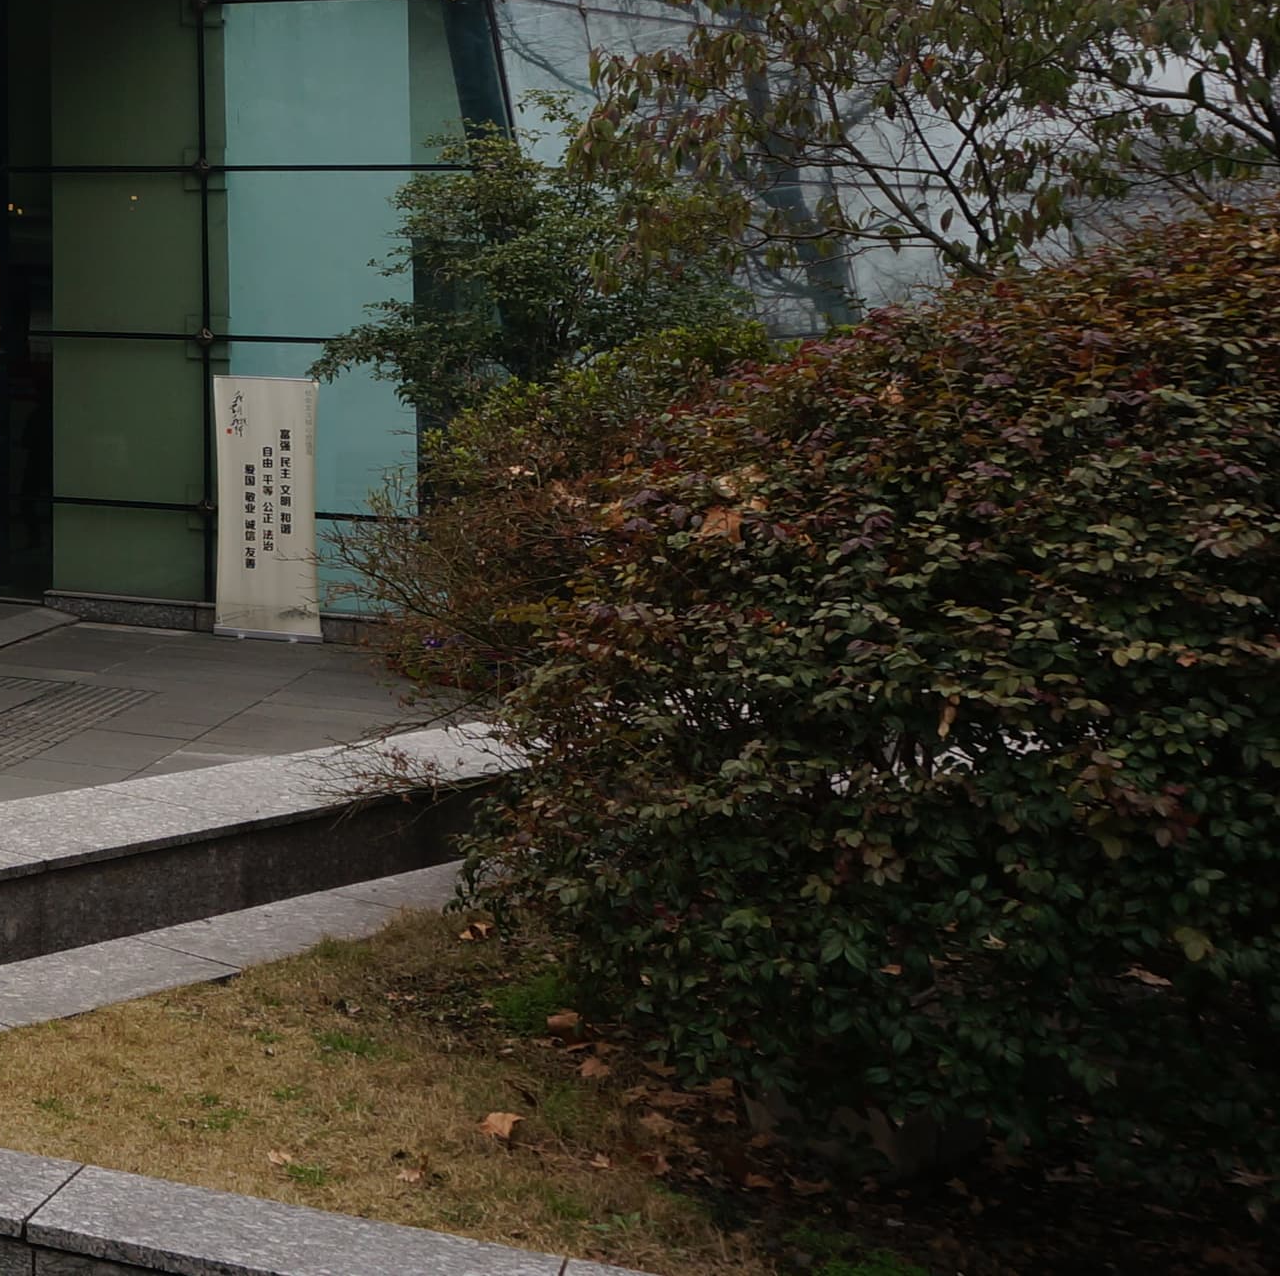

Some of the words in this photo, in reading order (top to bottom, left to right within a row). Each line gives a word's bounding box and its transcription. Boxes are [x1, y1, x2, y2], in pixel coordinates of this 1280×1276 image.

[262, 446, 273, 468] 自由
[280, 457, 291, 479] 民主
[280, 485, 291, 507] 文明
[262, 502, 273, 524] 公正
[262, 530, 273, 552] 法治
